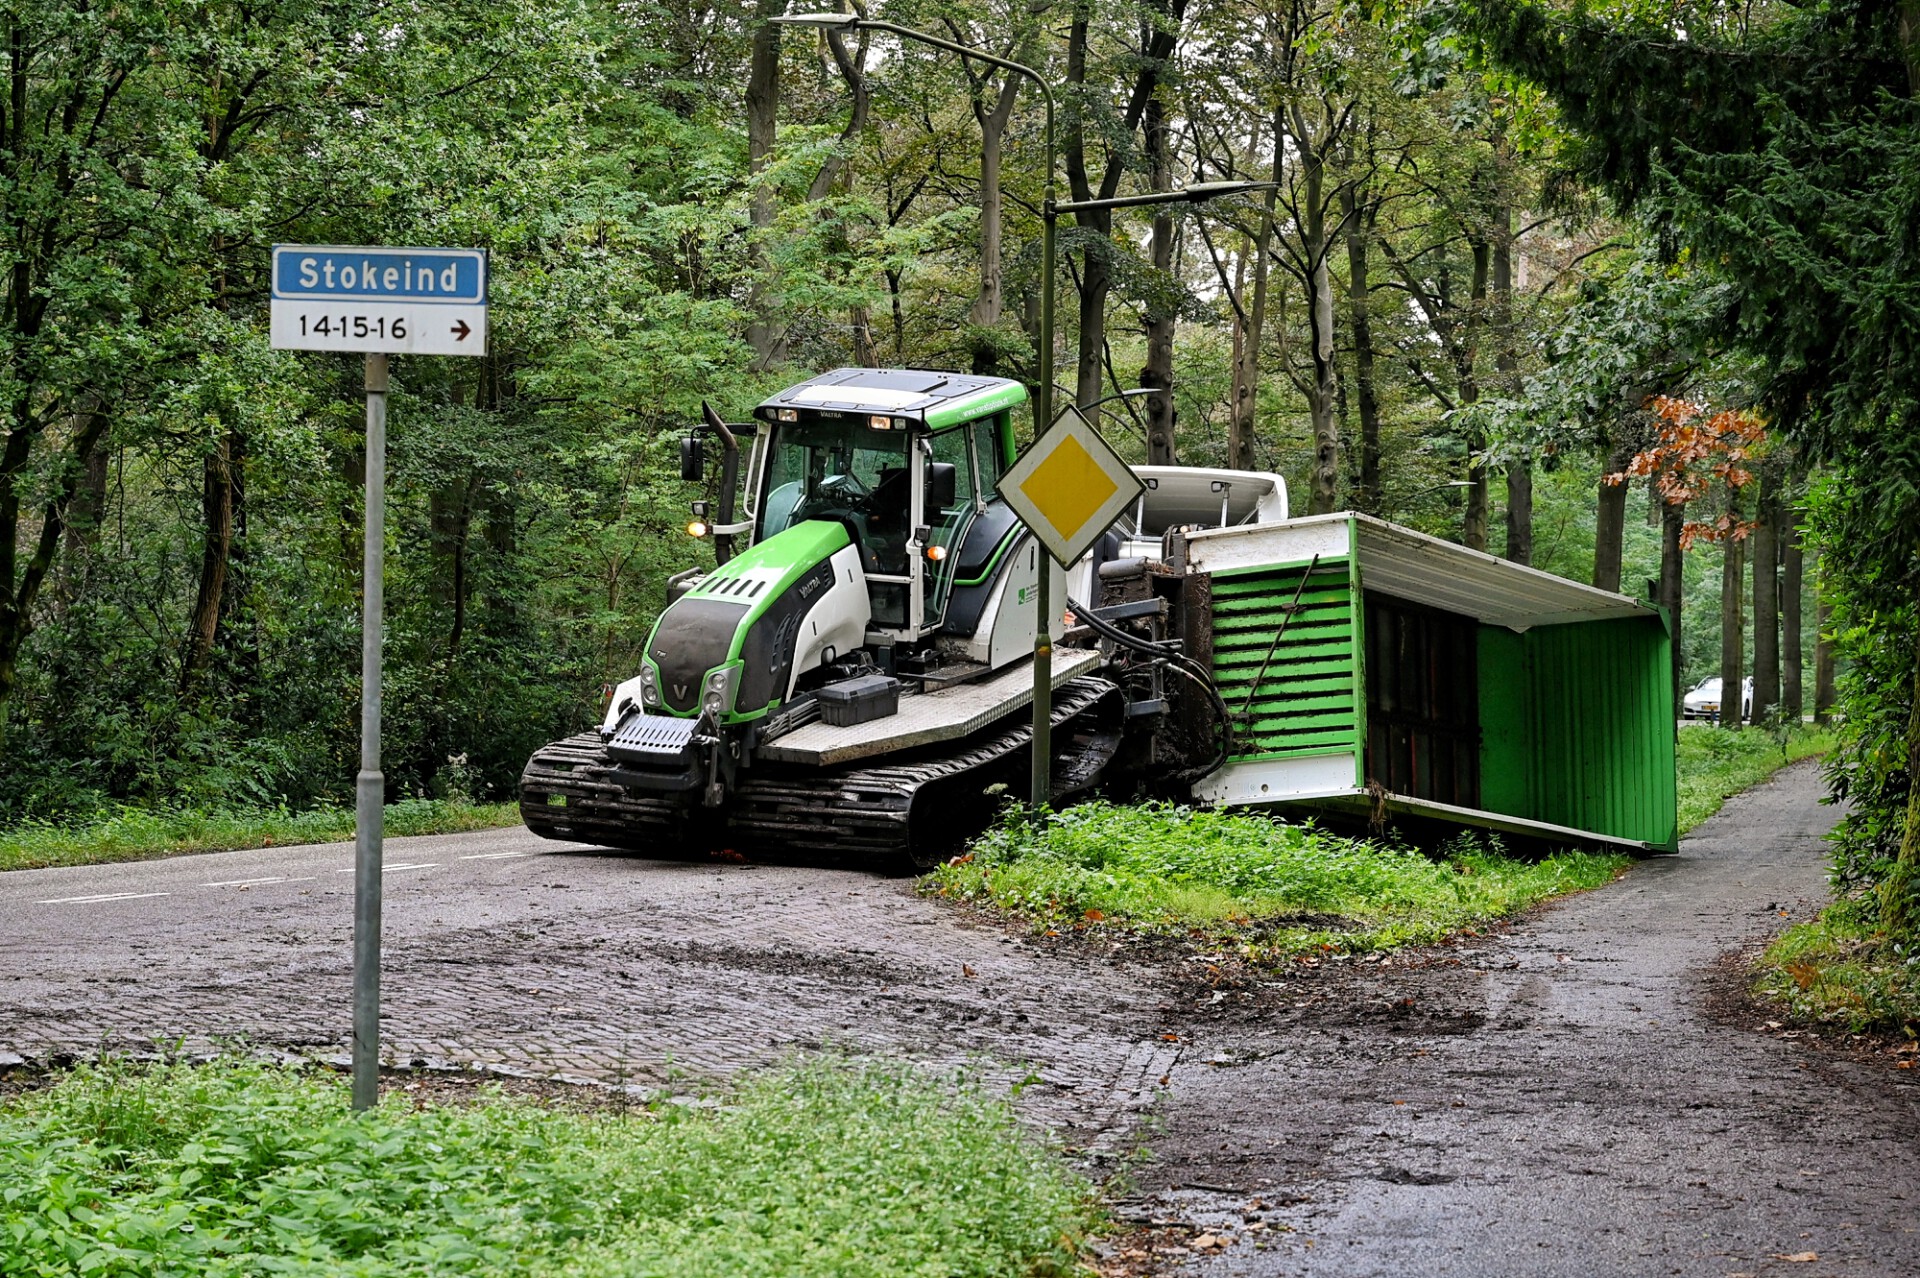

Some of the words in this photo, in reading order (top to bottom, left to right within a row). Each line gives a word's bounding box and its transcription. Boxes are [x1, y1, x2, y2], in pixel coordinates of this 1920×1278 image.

[299, 257, 457, 292] Stokeind
[299, 315, 407, 339] 14-15-16
[820, 410, 842, 419] VALTRA
[798, 576, 821, 599] VALTRA
